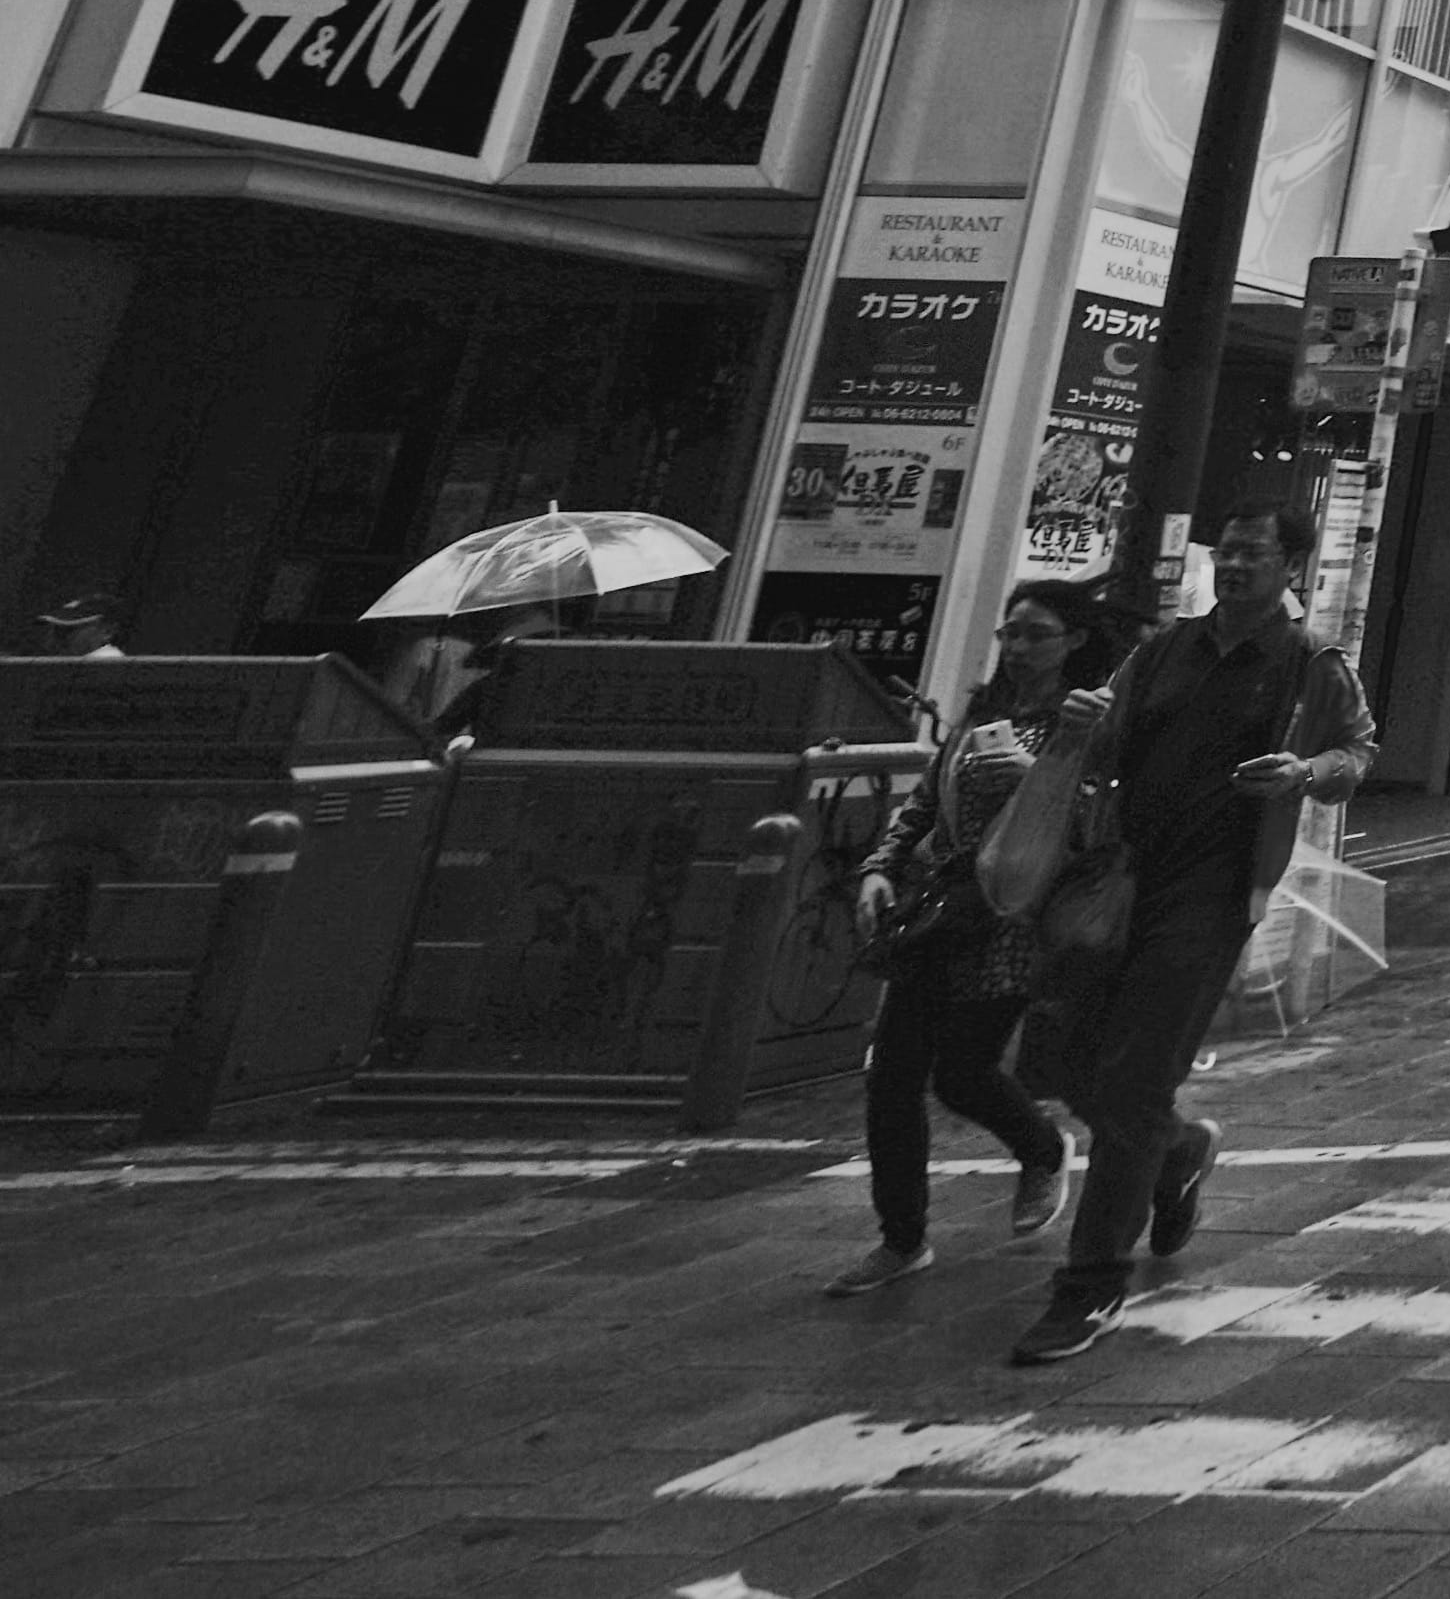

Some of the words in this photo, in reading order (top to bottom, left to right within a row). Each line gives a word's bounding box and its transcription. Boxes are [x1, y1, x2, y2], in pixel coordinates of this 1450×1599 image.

[880, 213, 1004, 232] RESTAURANT
[888, 245, 983, 264] KARAOKE
[857, 292, 981, 321] カラオケ
[941, 435, 967, 452] 6F
[907, 582, 934, 601] 5F
